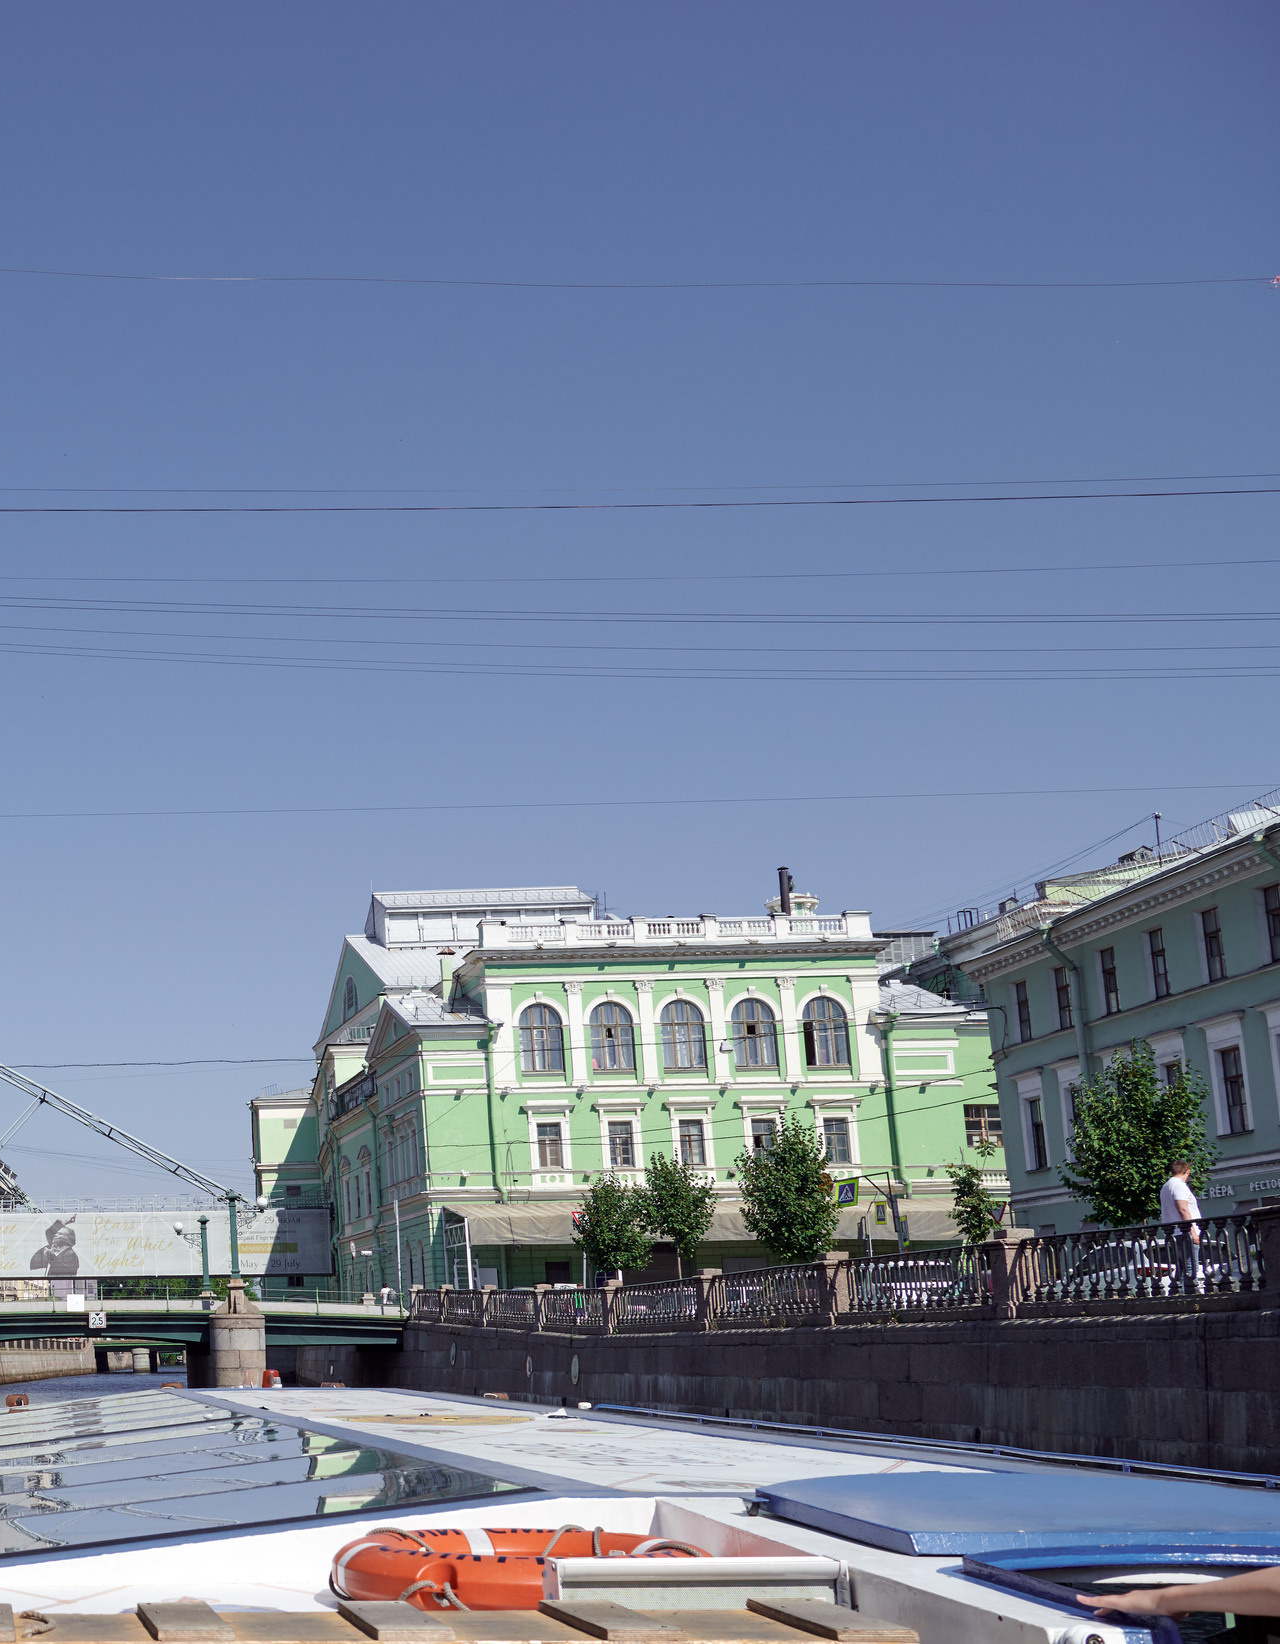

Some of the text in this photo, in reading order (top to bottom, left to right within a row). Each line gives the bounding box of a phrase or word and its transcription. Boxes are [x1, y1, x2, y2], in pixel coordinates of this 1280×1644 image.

[1210, 1184, 1235, 1198] RÉPA
[93, 1216, 136, 1235] Stars
[264, 1216, 275, 1224] 29
[93, 1234, 175, 1251] of the White
[93, 1252, 145, 1275] Nights
[240, 1260, 259, 1269] May
[271, 1259, 282, 1268] 29
[284, 1259, 301, 1269] July
